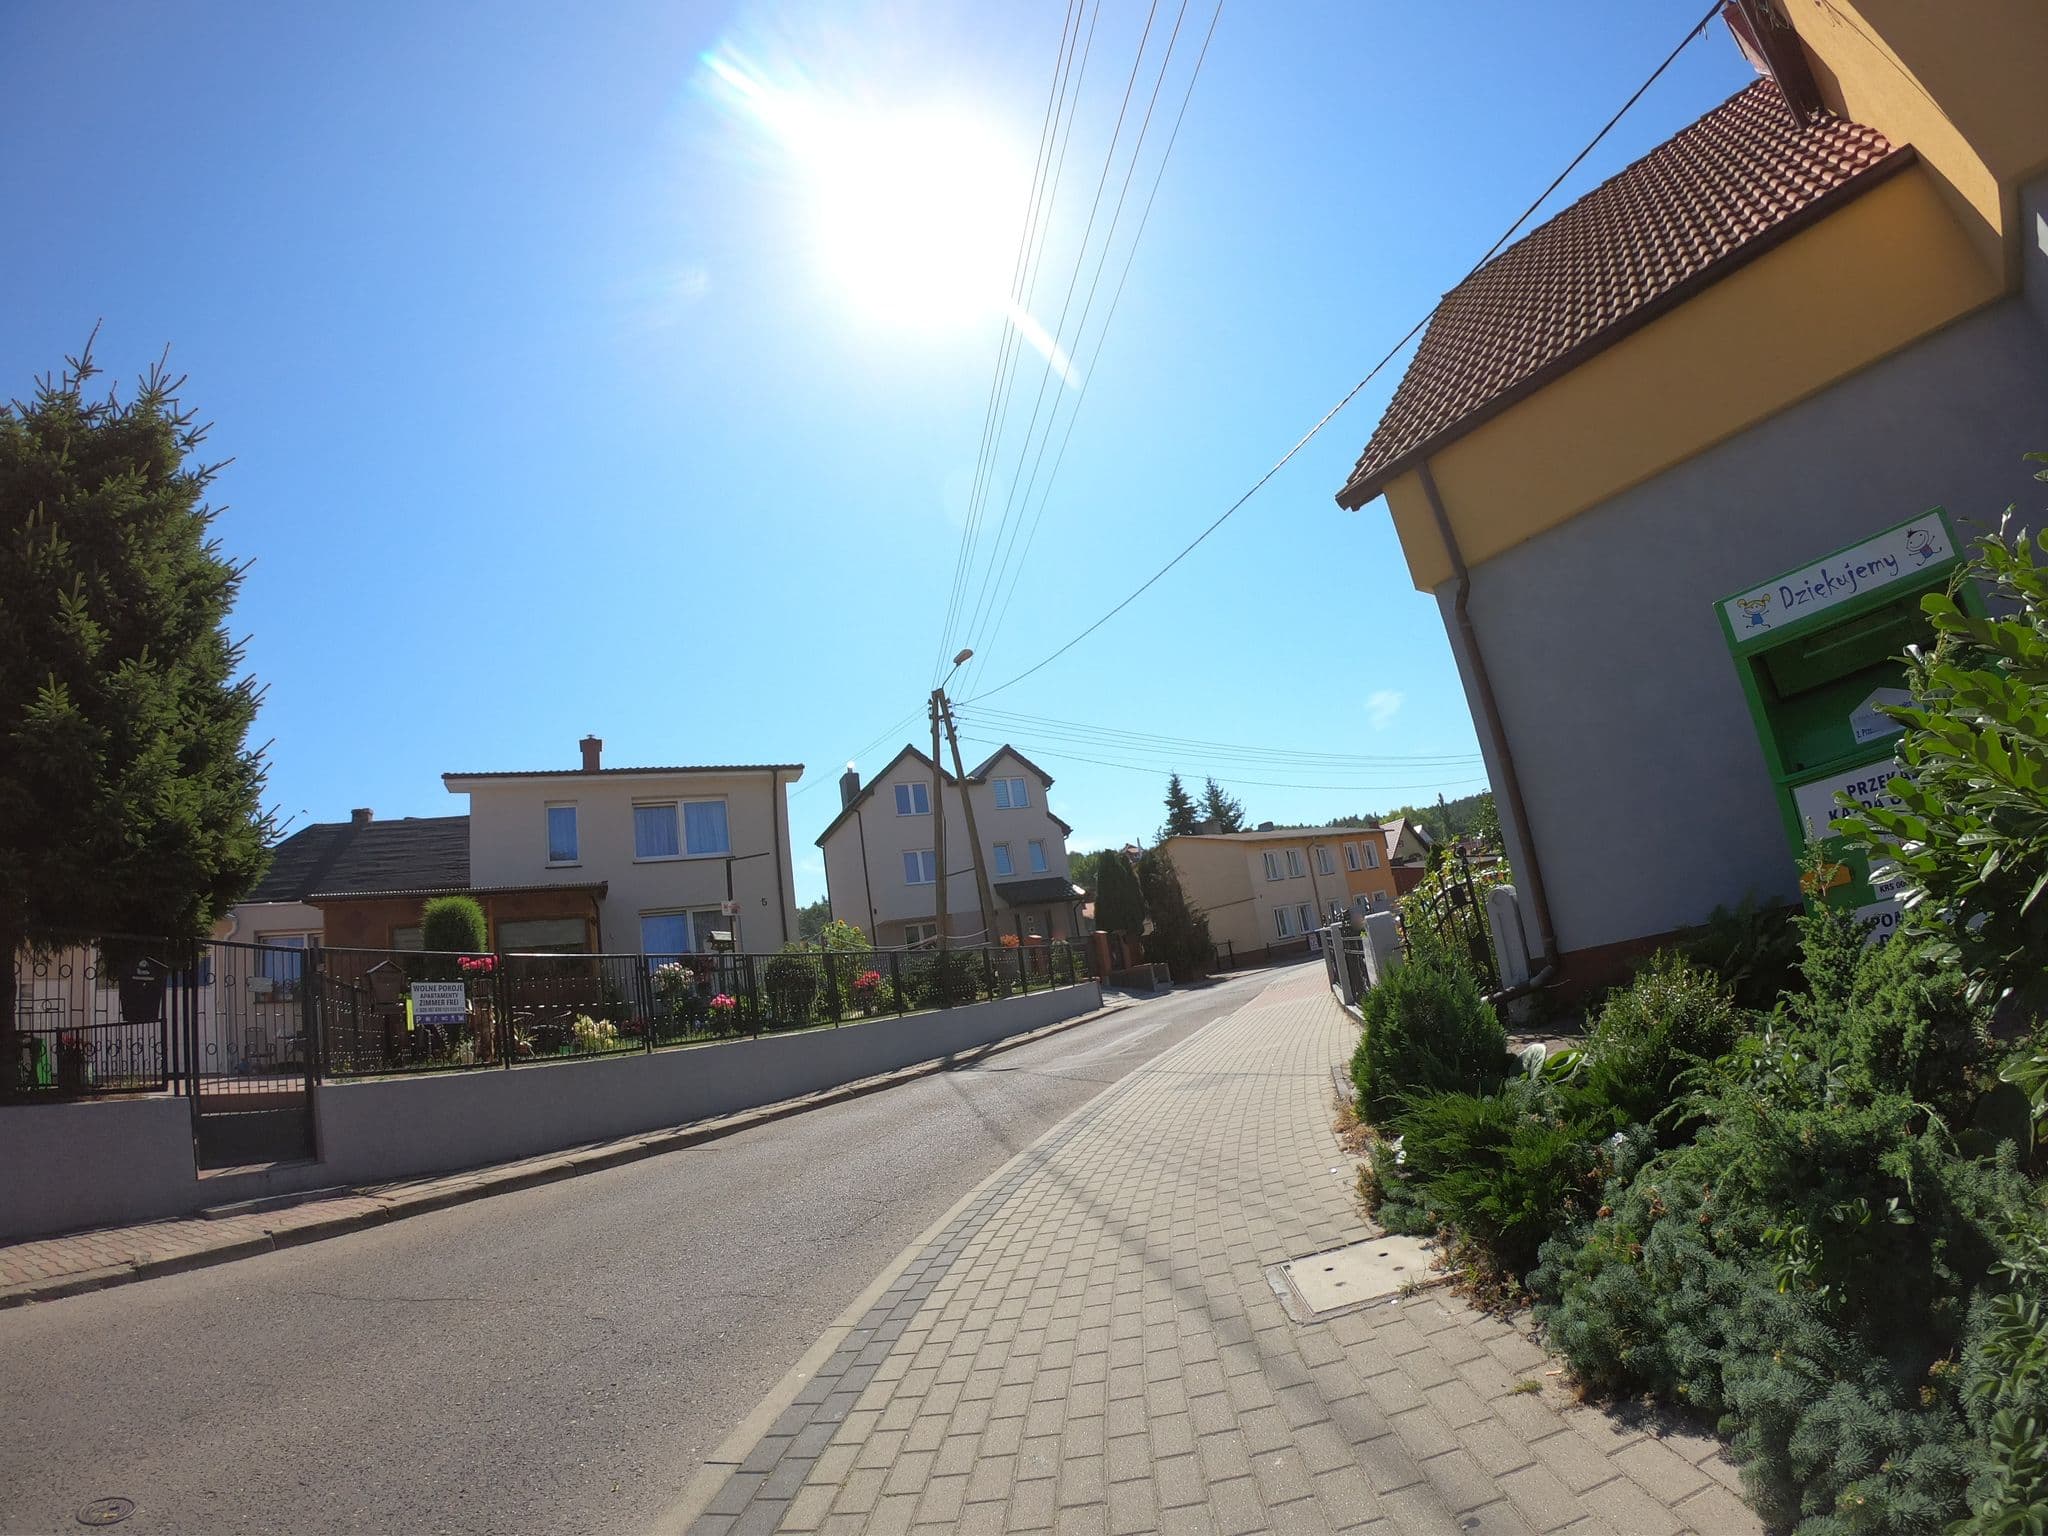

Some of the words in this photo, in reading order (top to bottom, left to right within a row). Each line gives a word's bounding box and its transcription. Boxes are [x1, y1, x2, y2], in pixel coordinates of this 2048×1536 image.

[1778, 554, 1899, 609] Dziękujemy
[413, 984, 436, 992] WOLNE
[438, 984, 463, 992] POKOJE
